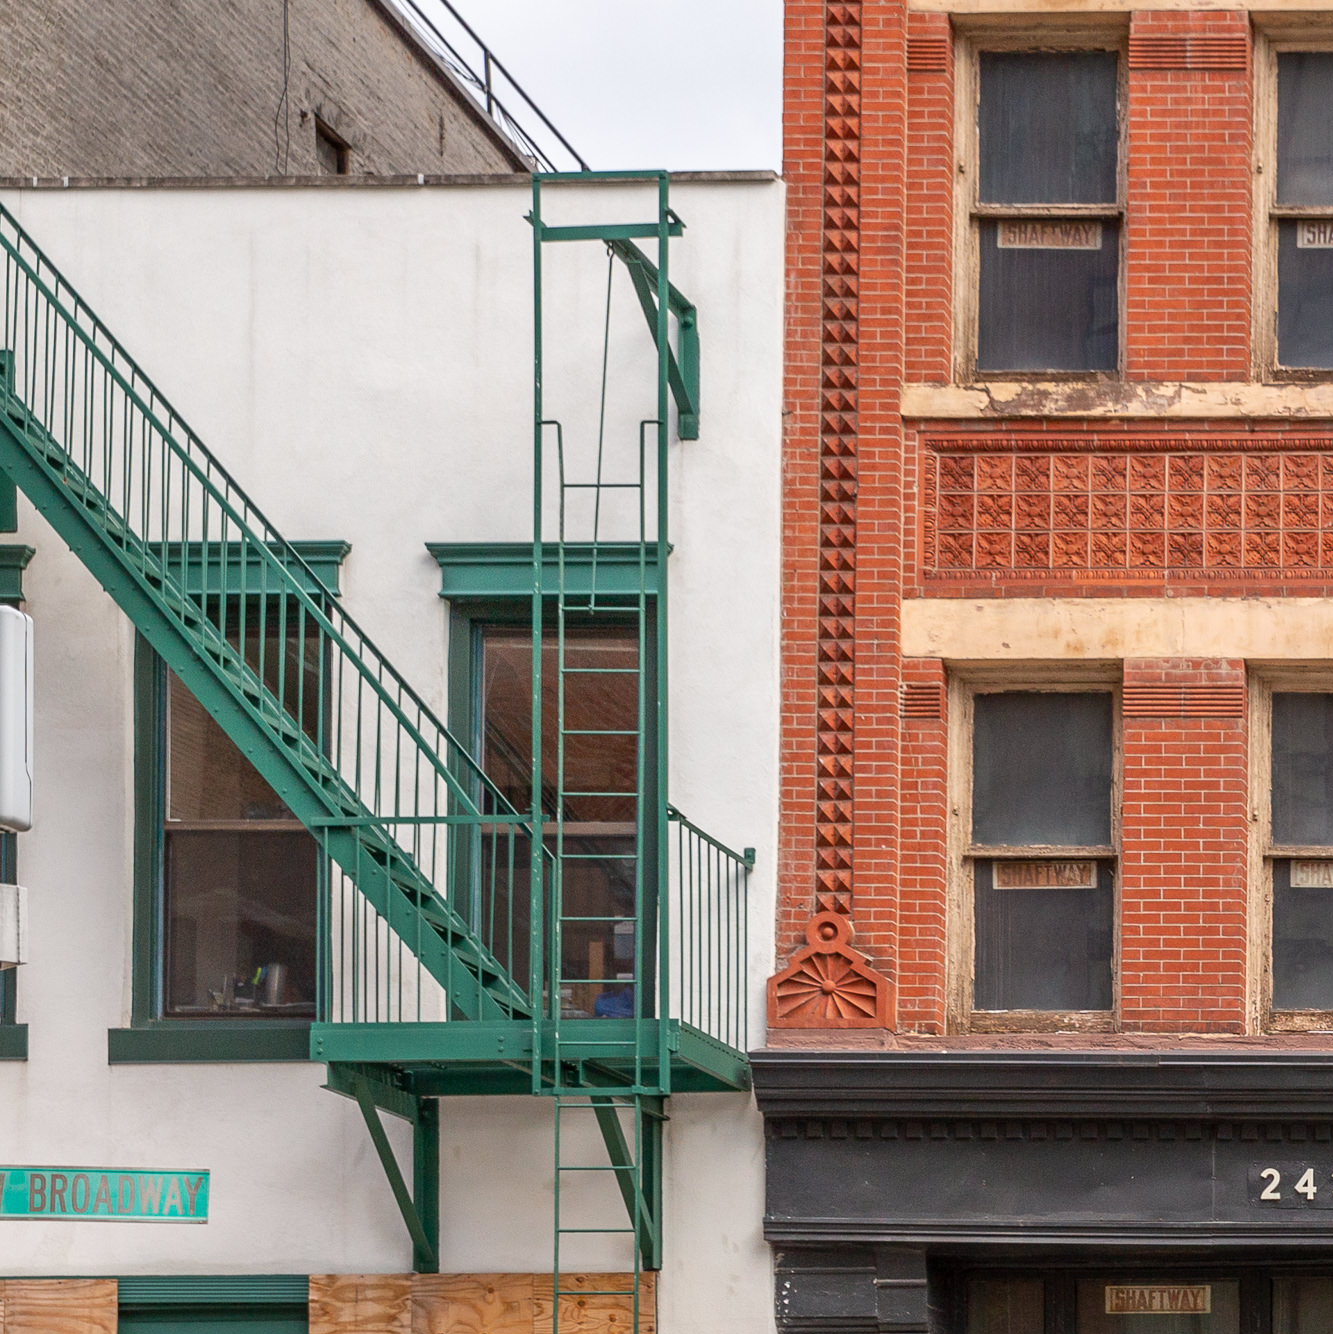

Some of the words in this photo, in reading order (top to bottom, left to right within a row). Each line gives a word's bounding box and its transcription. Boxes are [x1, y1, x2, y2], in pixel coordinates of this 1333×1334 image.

[1007, 221, 1092, 245] SHAFTWAY
[1000, 863, 1087, 885] SHAFTWAY
[28, 1173, 205, 1216] BROADWAY
[1115, 1288, 1201, 1311] SHAFTWAY
